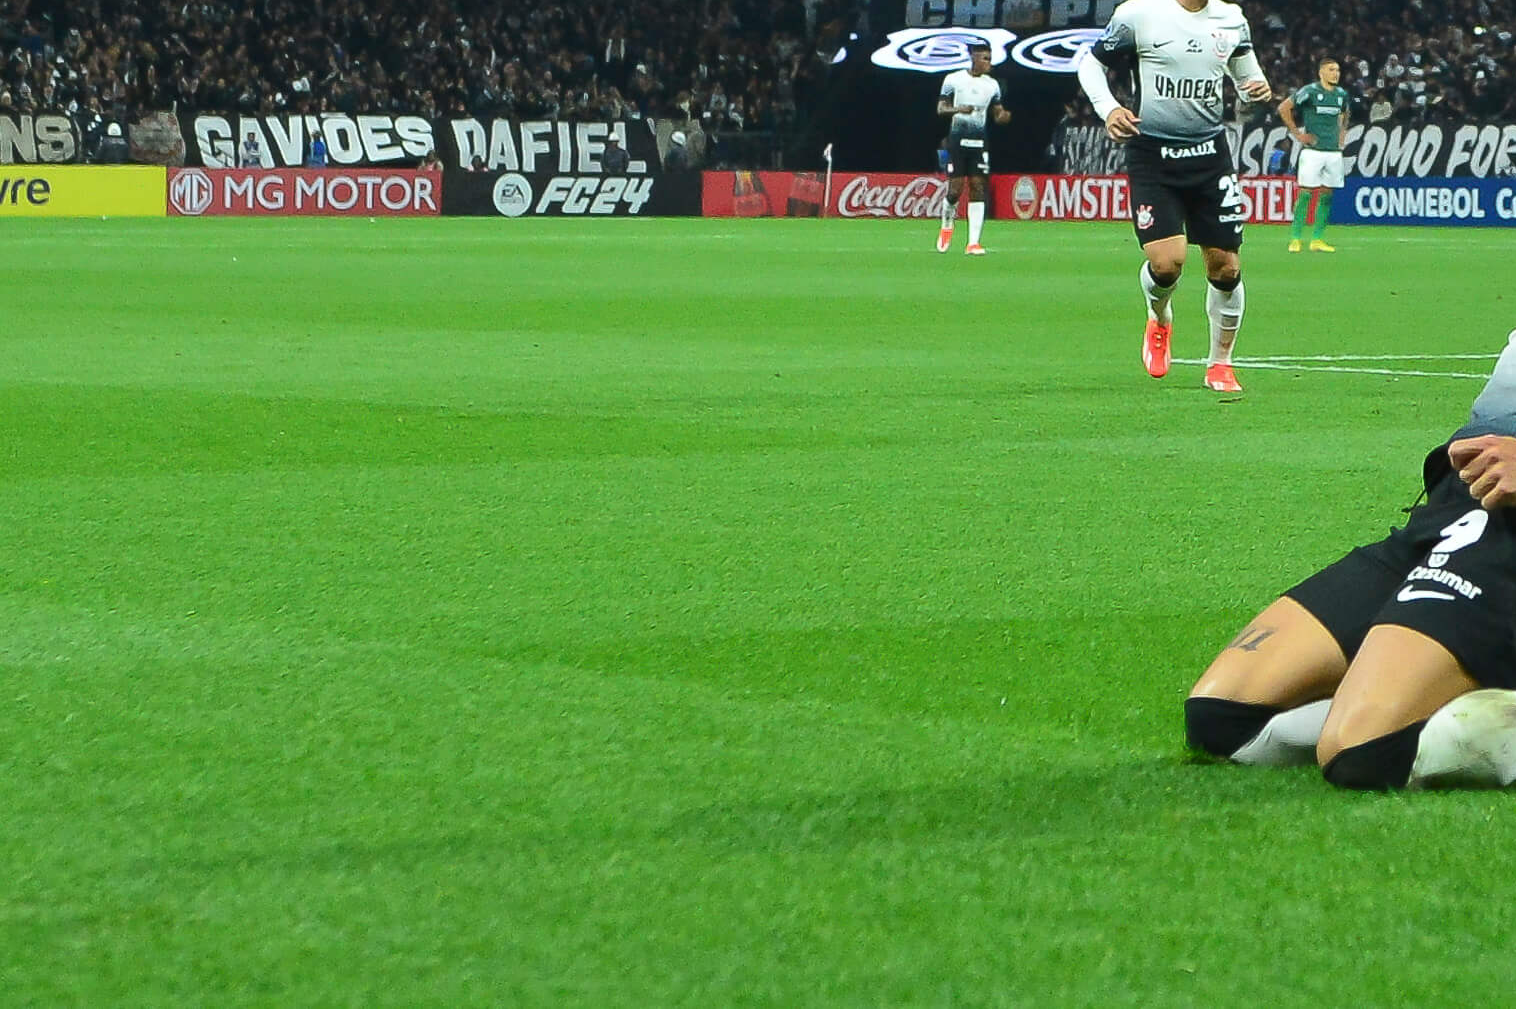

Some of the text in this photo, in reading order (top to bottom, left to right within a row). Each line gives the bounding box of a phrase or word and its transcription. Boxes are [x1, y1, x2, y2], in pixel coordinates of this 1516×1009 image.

[194, 111, 436, 169] GAVIÕES
[224, 175, 437, 212] MG MOTOR
[1040, 178, 1132, 219] AMSTE
[1238, 179, 1294, 221] STEL
[1355, 186, 1485, 218] CONMEBOL
